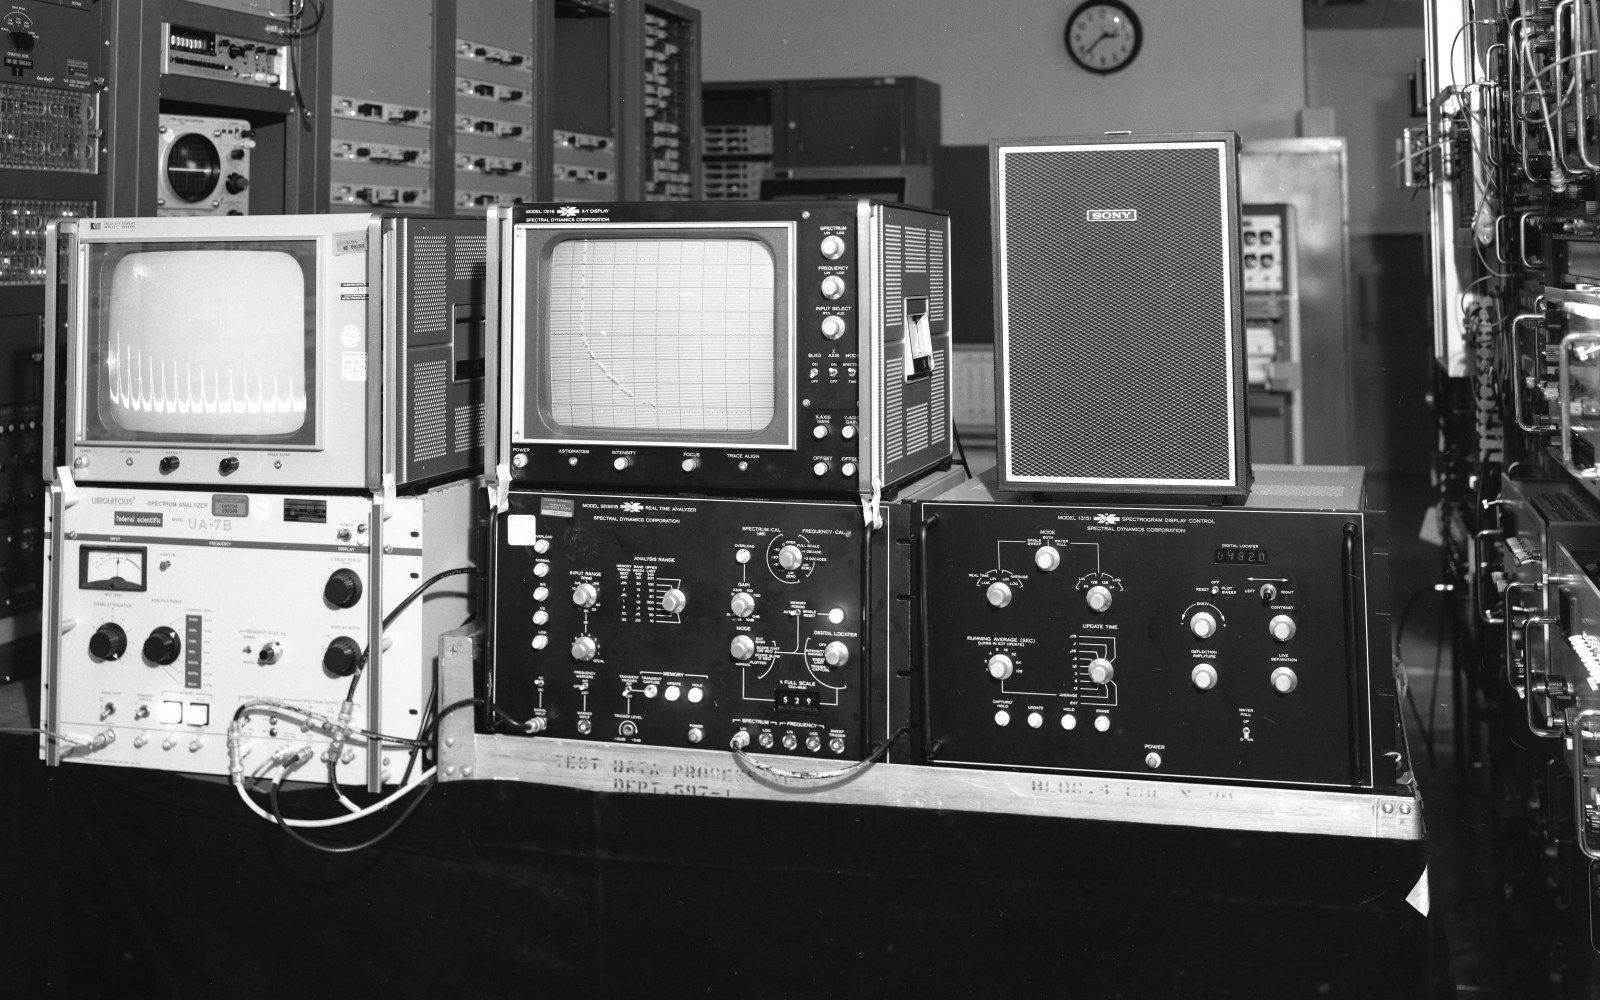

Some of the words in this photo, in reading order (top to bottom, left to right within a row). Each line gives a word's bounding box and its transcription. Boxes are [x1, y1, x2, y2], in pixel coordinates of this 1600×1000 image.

[1092, 211, 1132, 220] SONY
[178, 501, 208, 509] ANALYZER
[115, 515, 135, 523] federal
[136, 516, 161, 524] scientific
[188, 518, 232, 531] UA-7B
[1217, 550, 1265, 562] 04820
[555, 754, 600, 770] TEST
